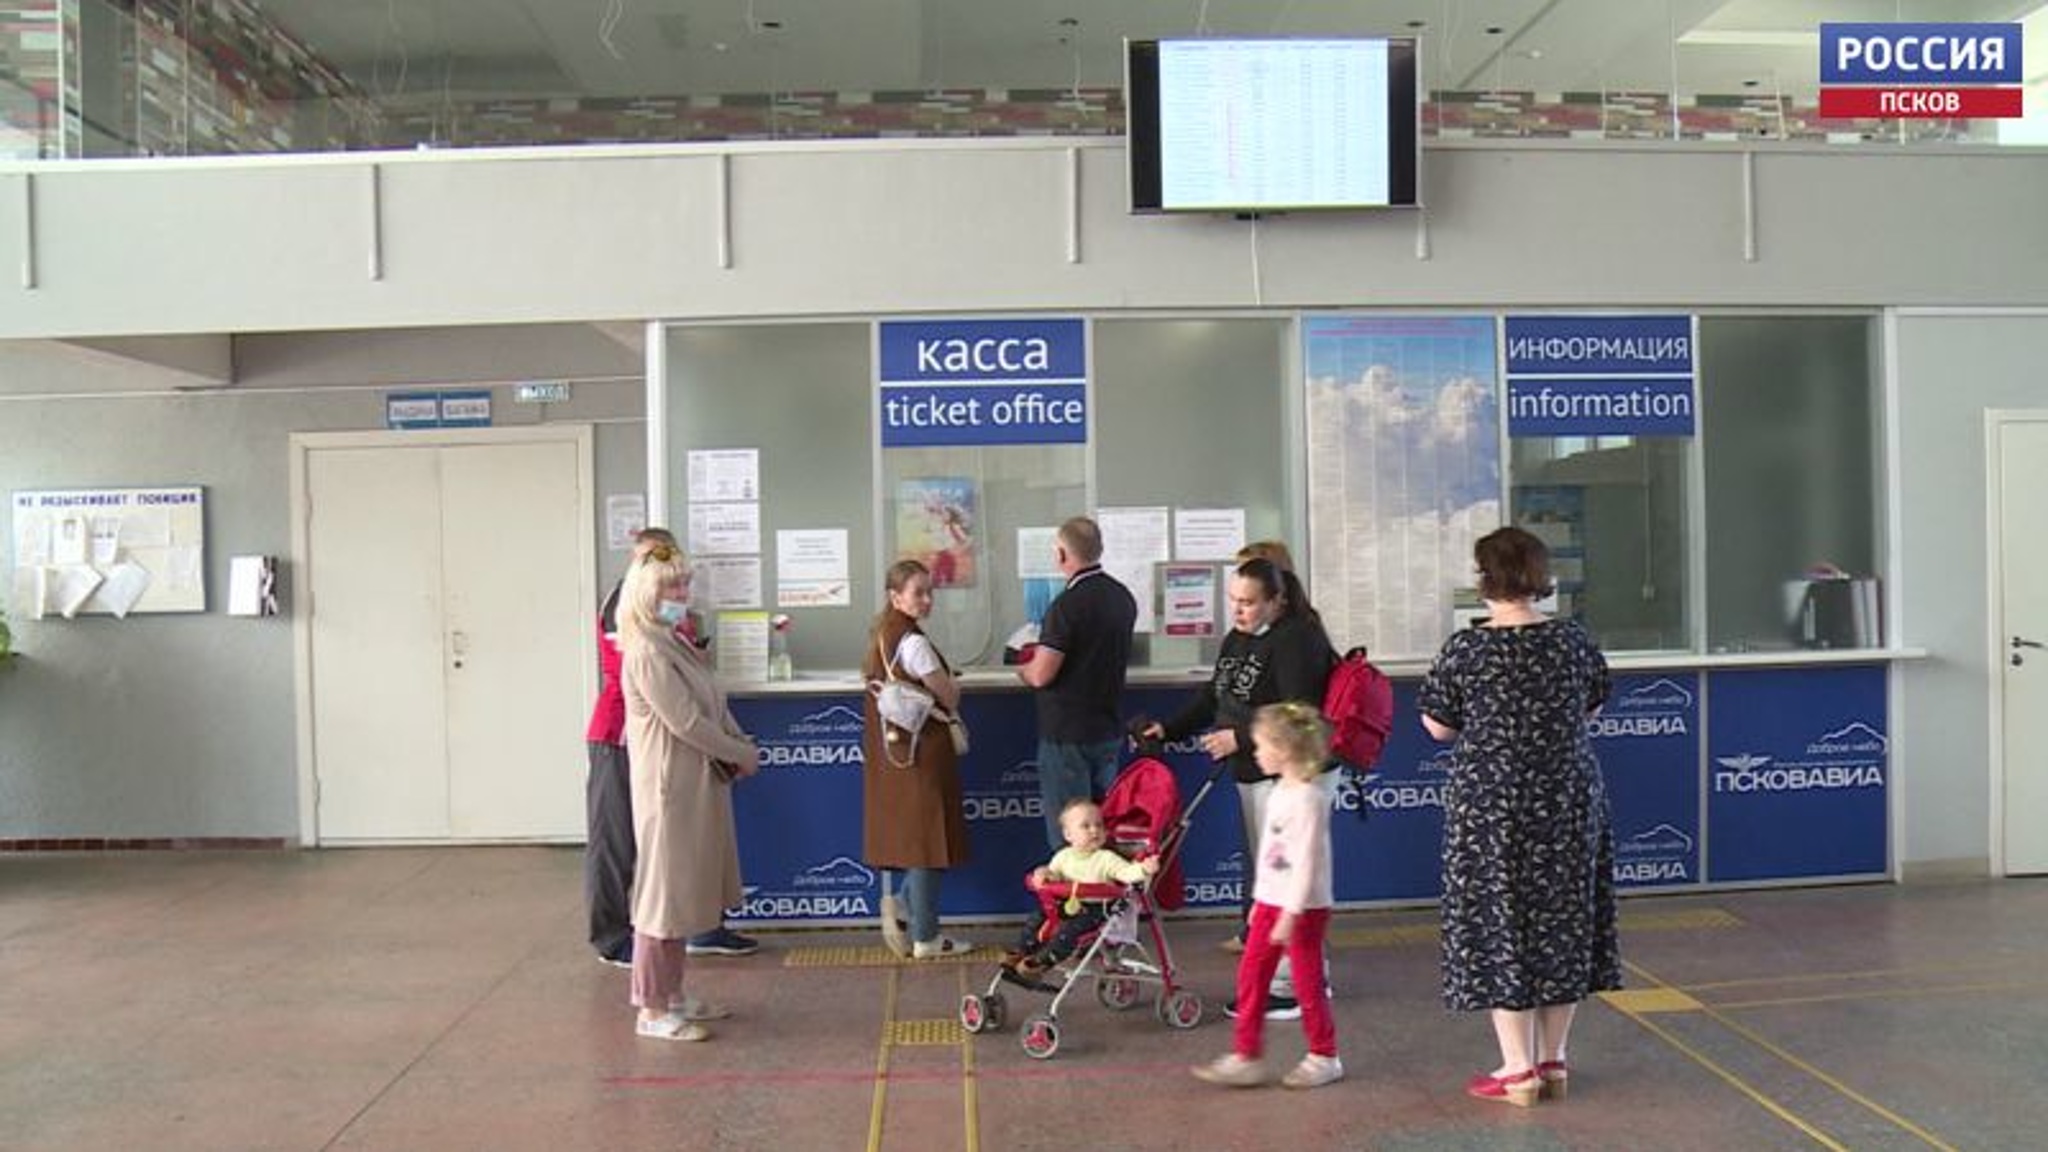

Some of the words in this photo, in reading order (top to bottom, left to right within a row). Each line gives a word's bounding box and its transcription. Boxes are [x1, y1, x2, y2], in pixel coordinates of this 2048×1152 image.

[917, 337, 1049, 371] касса
[1509, 337, 1688, 362] ИНФОРМАЦИЯ
[886, 395, 981, 426] ticket
[992, 393, 1083, 424] office
[1510, 386, 1690, 418] information
[1715, 766, 1884, 792] ПСКОВАВИА
